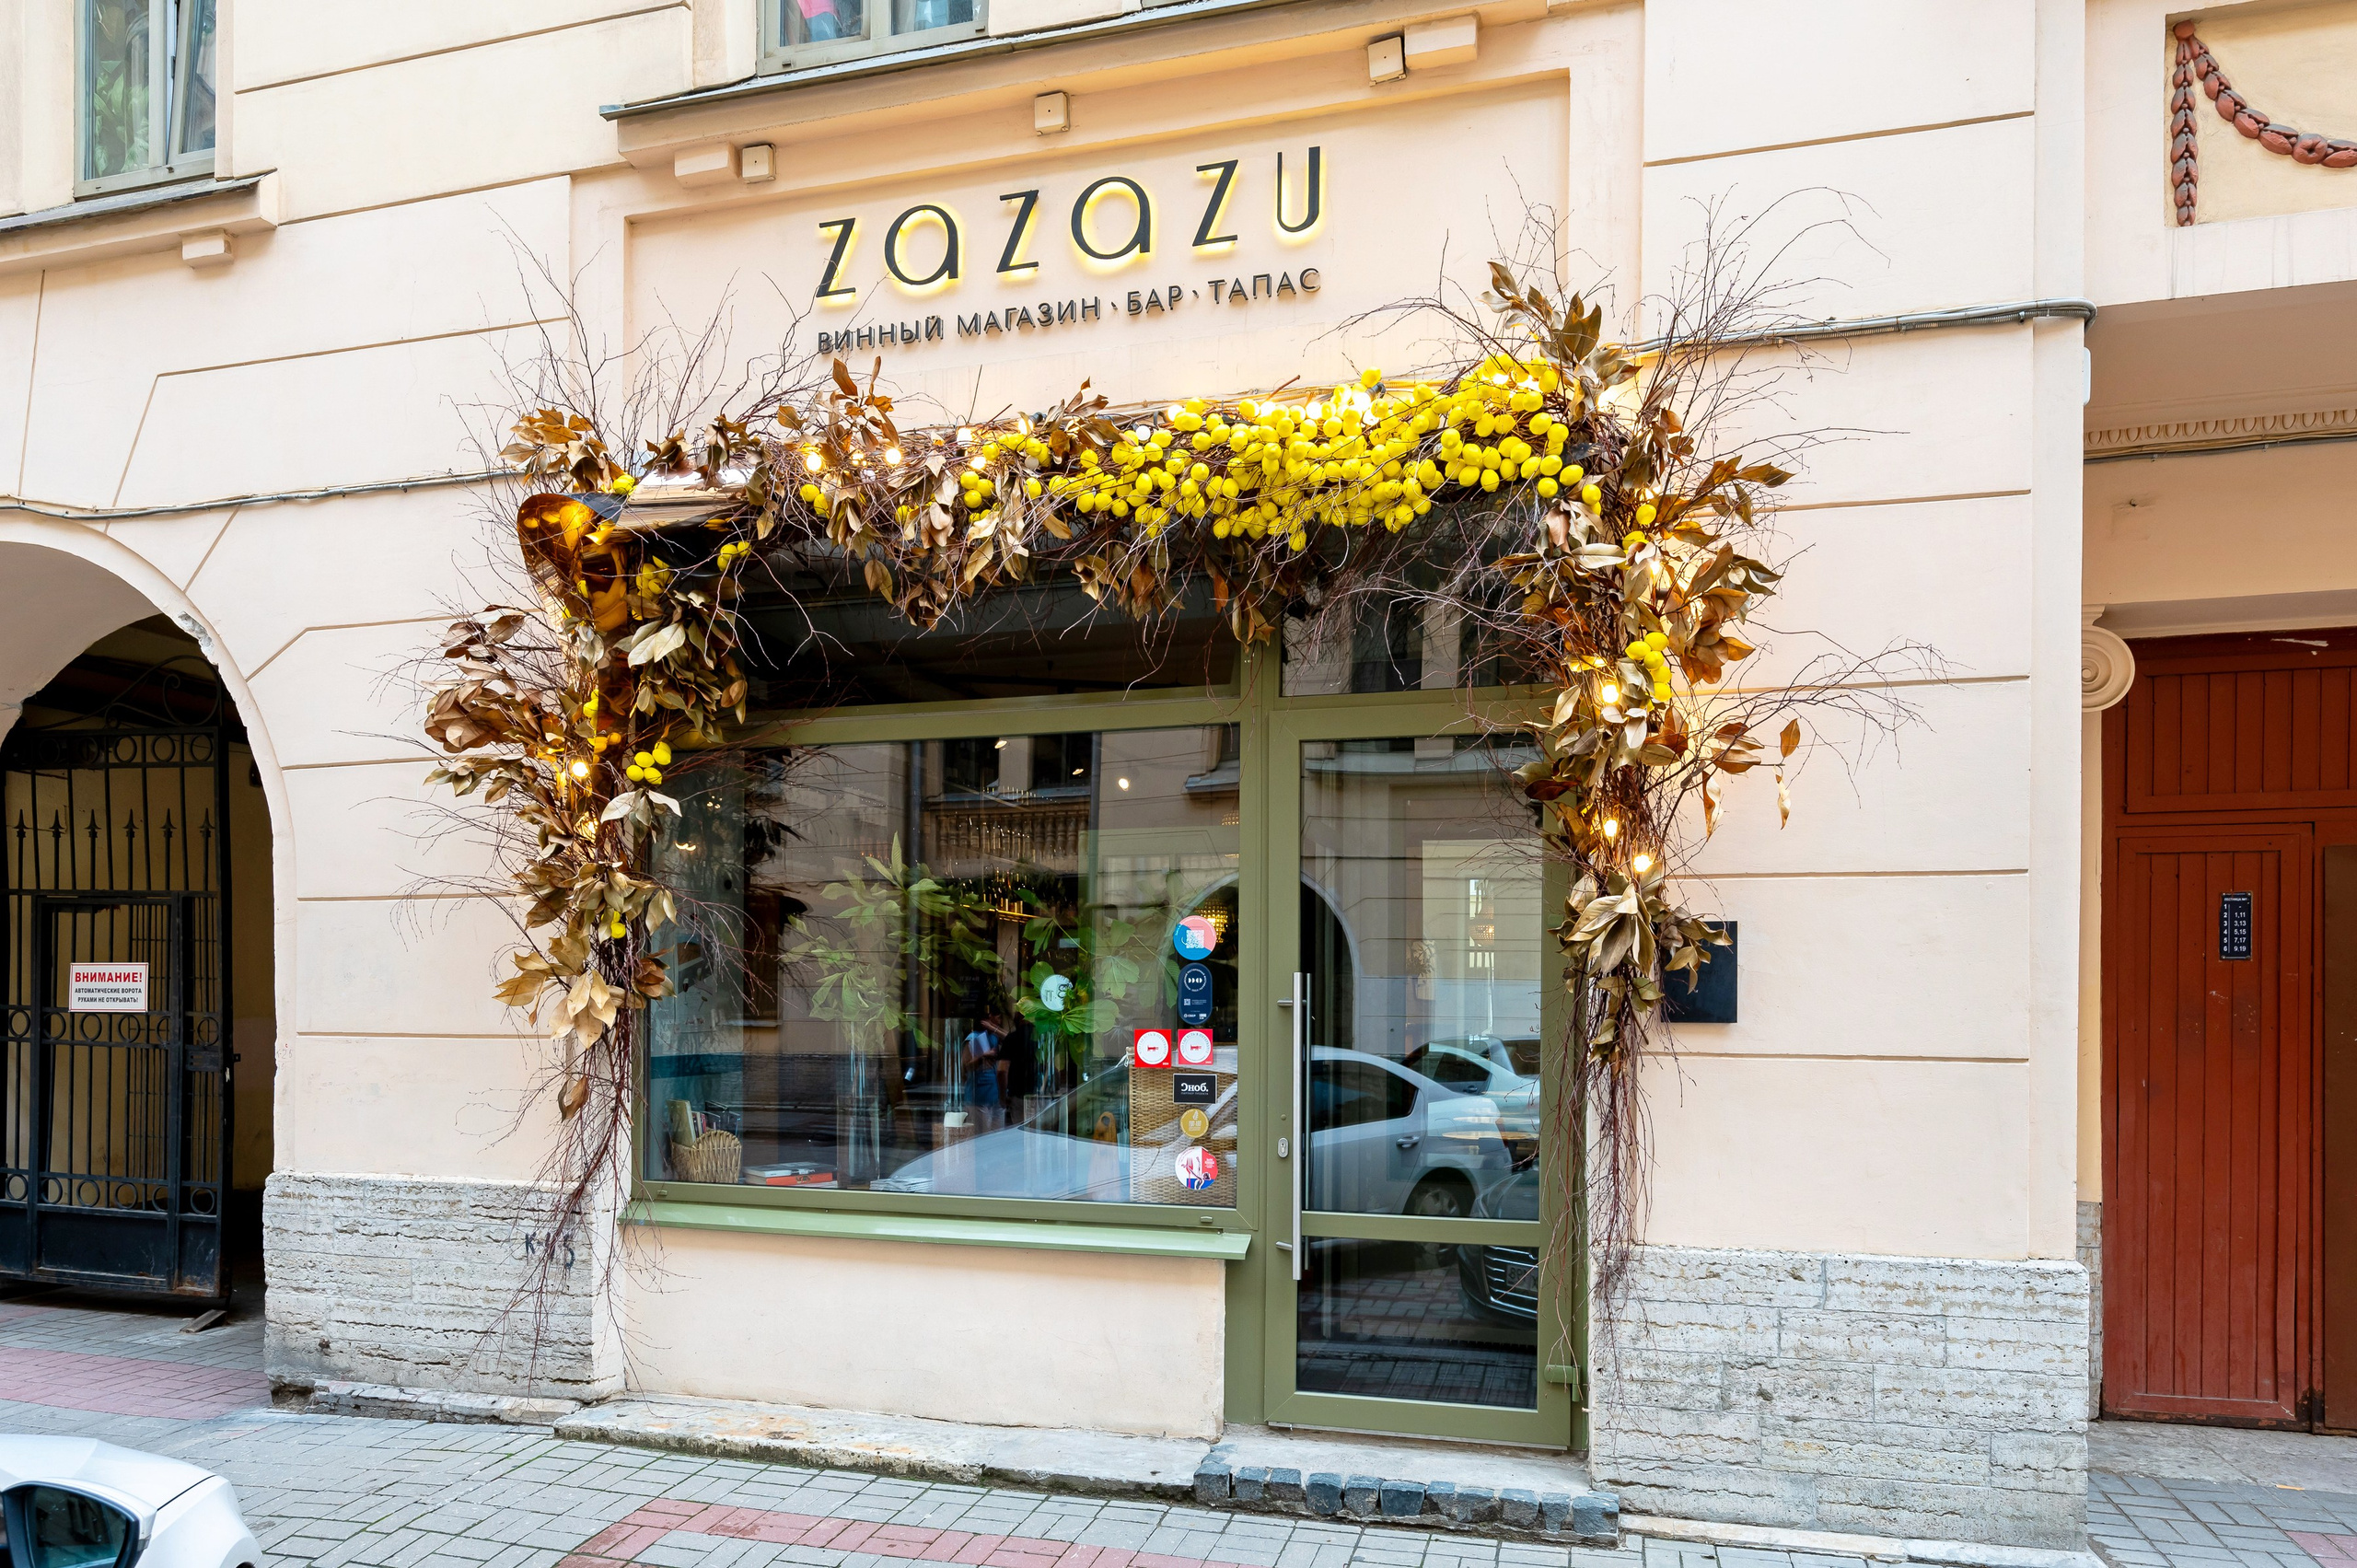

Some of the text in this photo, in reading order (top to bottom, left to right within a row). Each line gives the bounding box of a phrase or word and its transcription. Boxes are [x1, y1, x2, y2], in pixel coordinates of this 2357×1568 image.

[818, 267, 1321, 355] ВИННЫЙ МАГАЗИН БАР ТАПАС
[75, 972, 142, 982] ВНИМАНИЕ!
